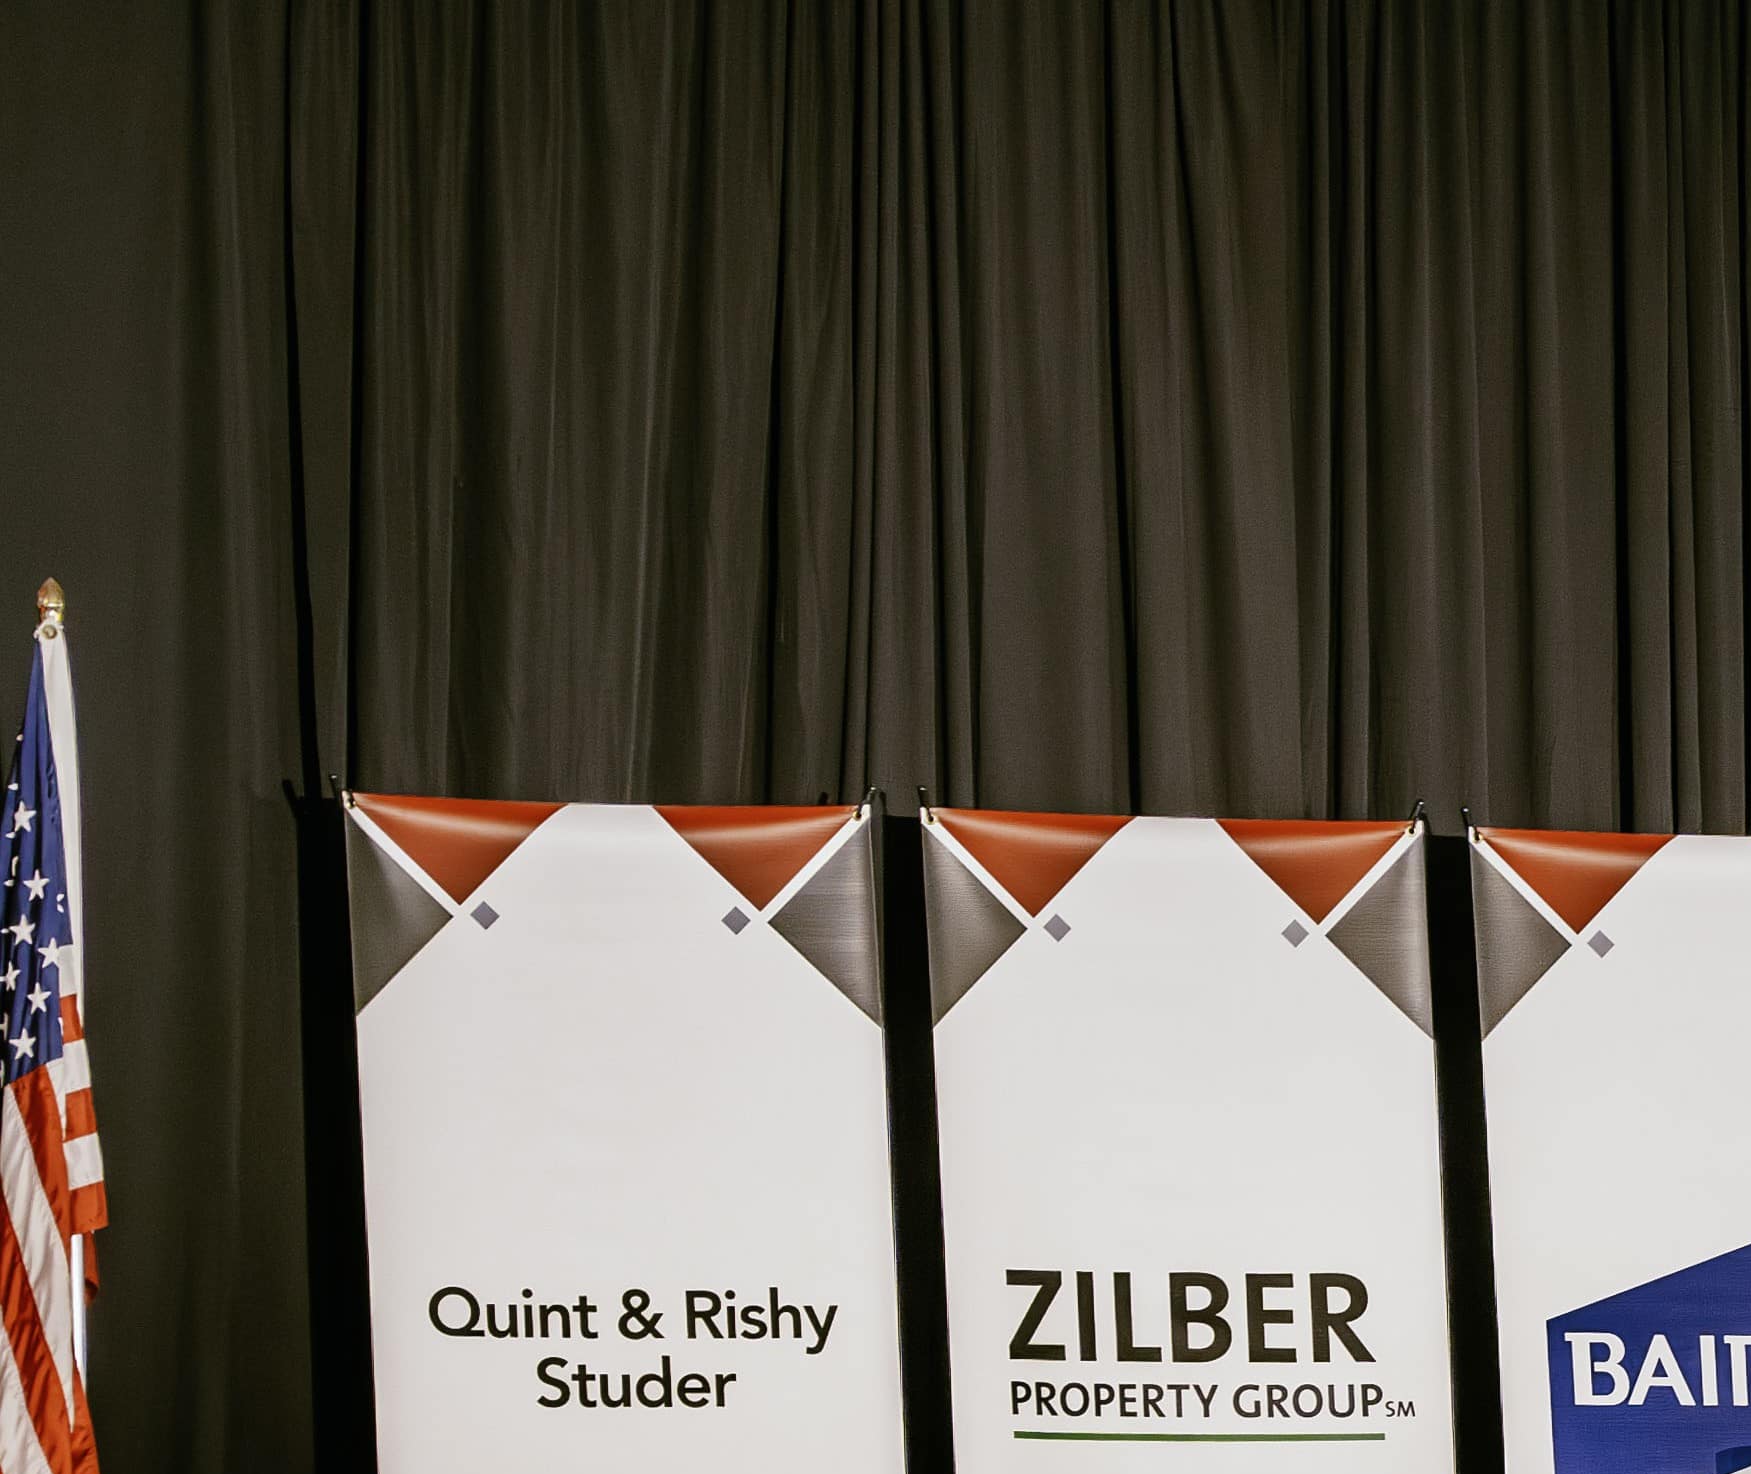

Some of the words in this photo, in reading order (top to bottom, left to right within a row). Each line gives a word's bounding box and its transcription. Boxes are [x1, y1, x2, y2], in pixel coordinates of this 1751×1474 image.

[428, 1286, 600, 1340] Quint
[617, 1288, 666, 1341] &
[685, 1286, 839, 1355] Rishy
[1005, 1268, 1378, 1363] ZILBER
[536, 1355, 738, 1409] Studer
[1010, 1380, 1220, 1418] PROPERTY
